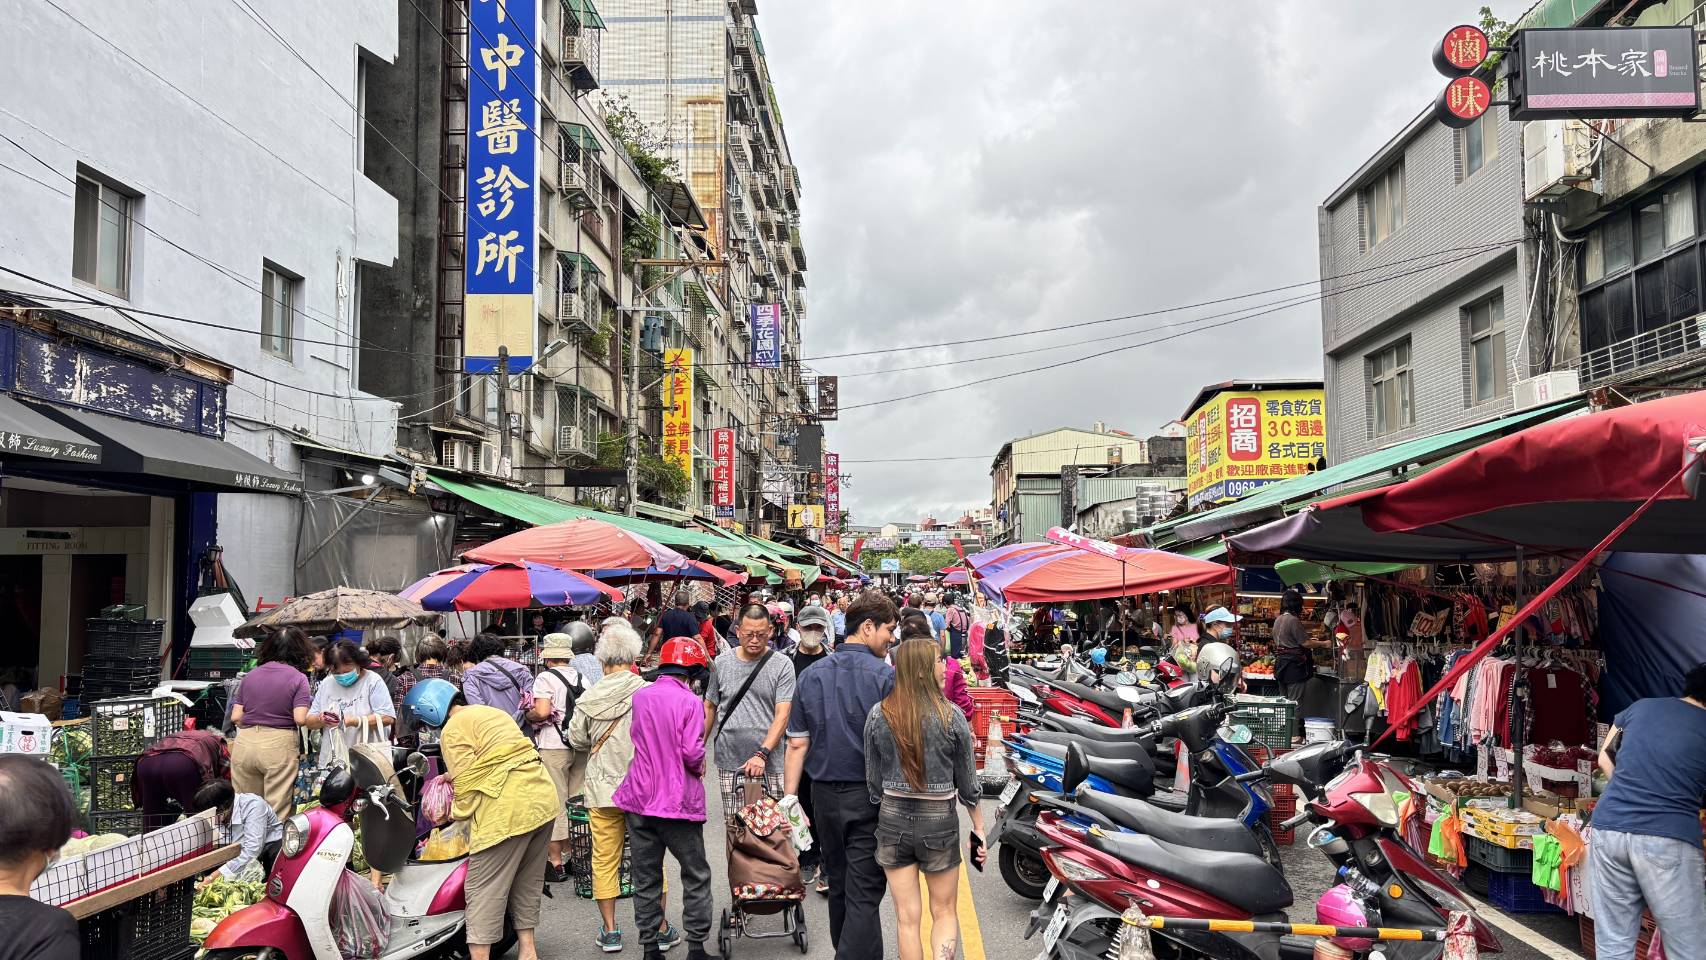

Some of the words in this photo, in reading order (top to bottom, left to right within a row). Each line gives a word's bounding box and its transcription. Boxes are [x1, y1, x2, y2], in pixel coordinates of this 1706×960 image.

[1532, 48, 1651, 78] 桃本家
[756, 304, 775, 350] 四季花園
[756, 351, 775, 359] KTV
[1266, 400, 1322, 416] 零食乾貨
[1230, 403, 1258, 453] 招商
[23, 438, 60, 457] Luxury
[63, 444, 98, 460] Fashion
[1268, 442, 1324, 459] 各式百貨
[718, 432, 729, 504] 榮欣南北雜貨
